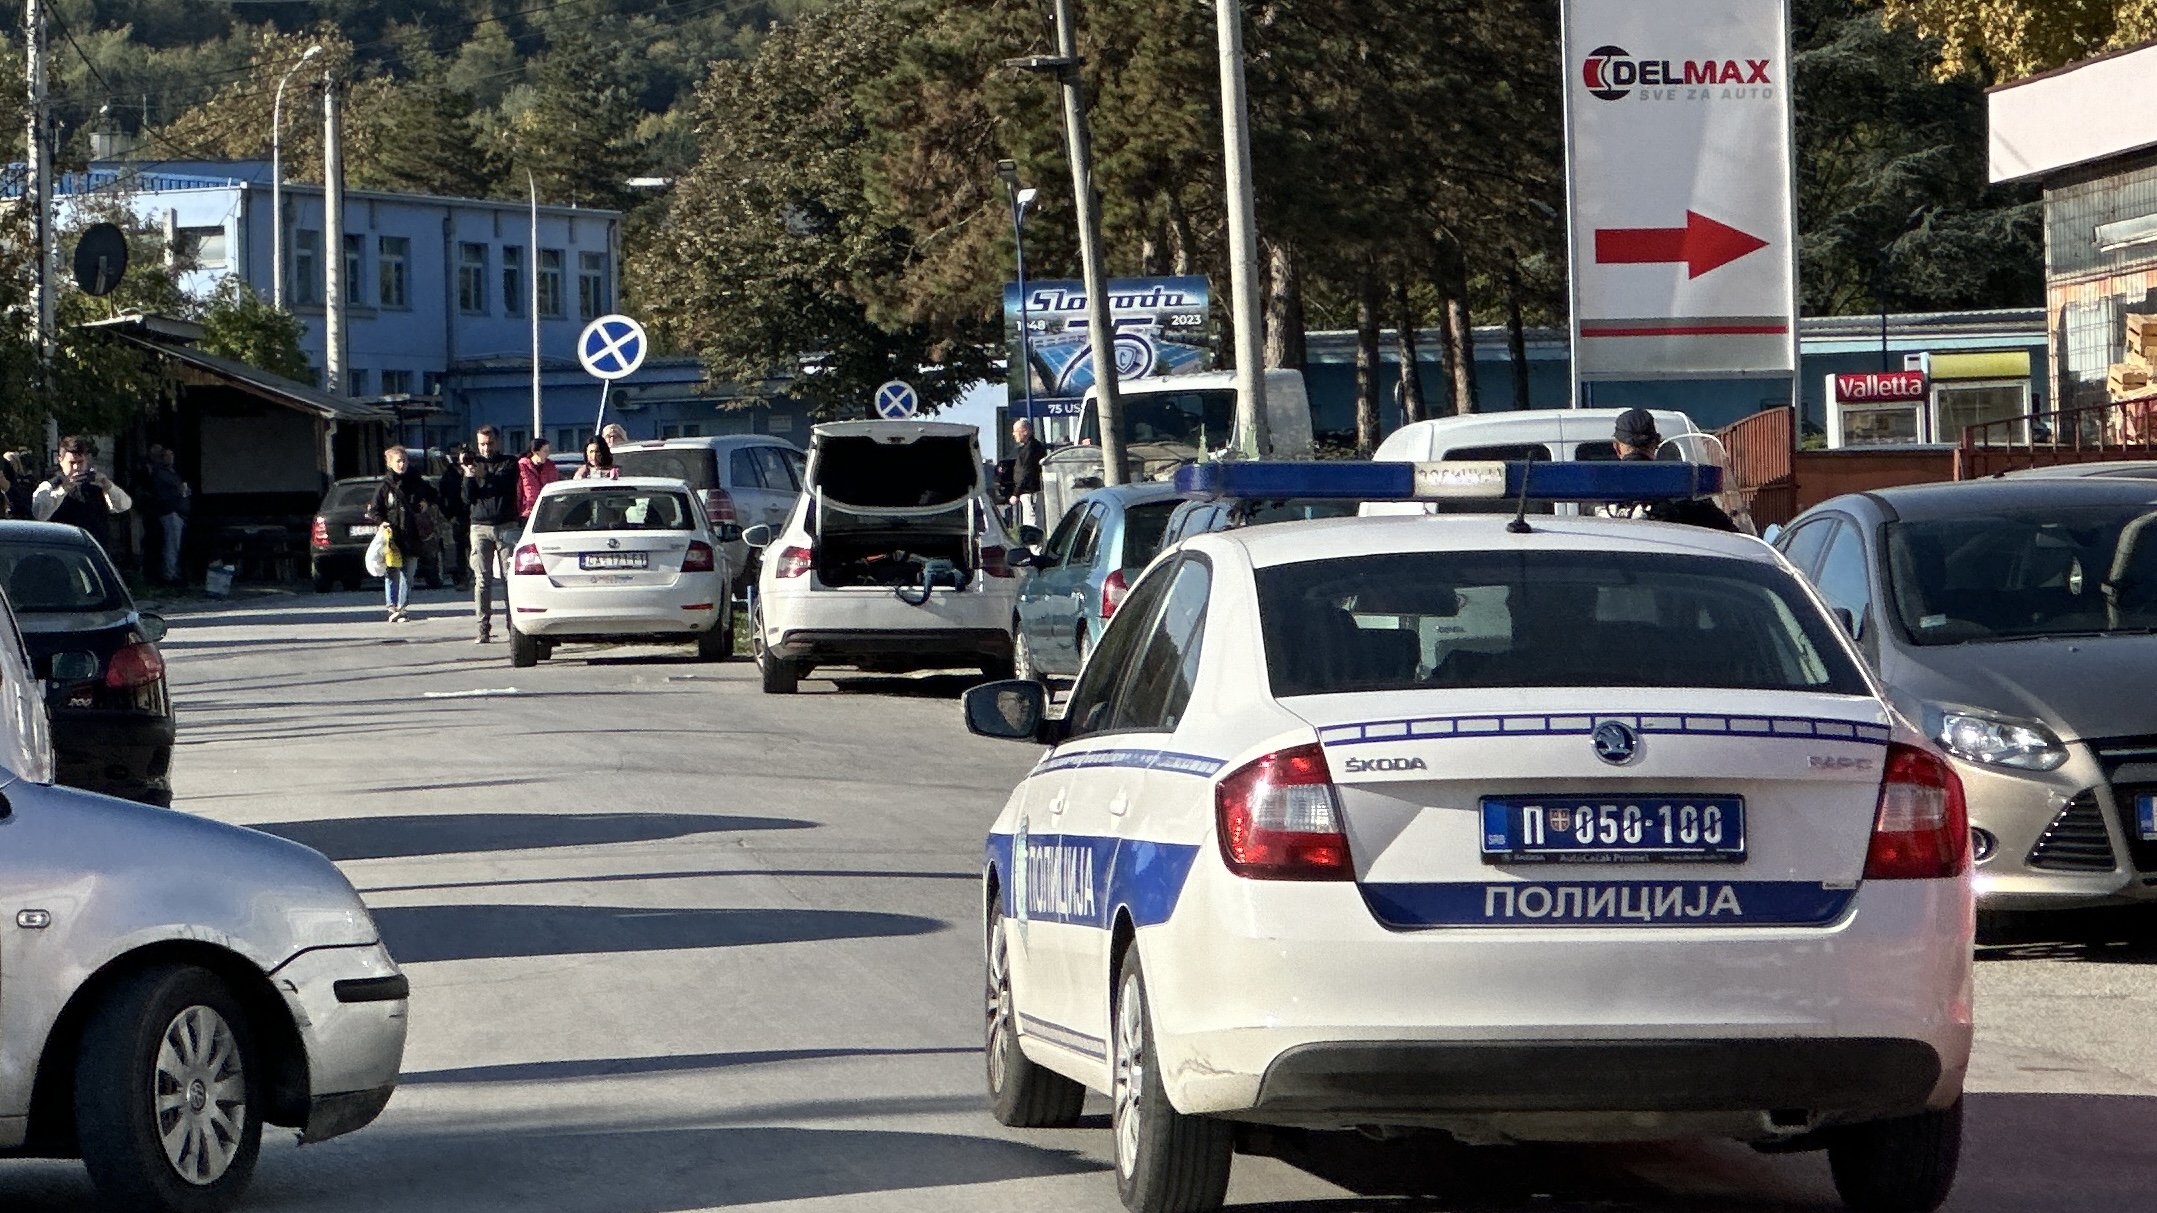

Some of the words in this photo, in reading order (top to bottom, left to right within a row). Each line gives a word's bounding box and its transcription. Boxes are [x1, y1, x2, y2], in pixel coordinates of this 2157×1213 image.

[1612, 59, 1771, 86] DELMAX
[1639, 88, 1676, 101] SVE
[1686, 88, 1710, 100] ZA
[1721, 87, 1773, 100] AUTO
[1017, 286, 1200, 313] Slooda
[1016, 319, 1046, 331] 148
[1171, 314, 1202, 326] 2023
[1838, 374, 1922, 398] Valletta
[1047, 403, 1063, 414] 75
[1345, 756, 1428, 773] ŠKODA
[1522, 805, 1545, 845] П
[1484, 885, 1743, 922] ПОЛИЦИЈА
